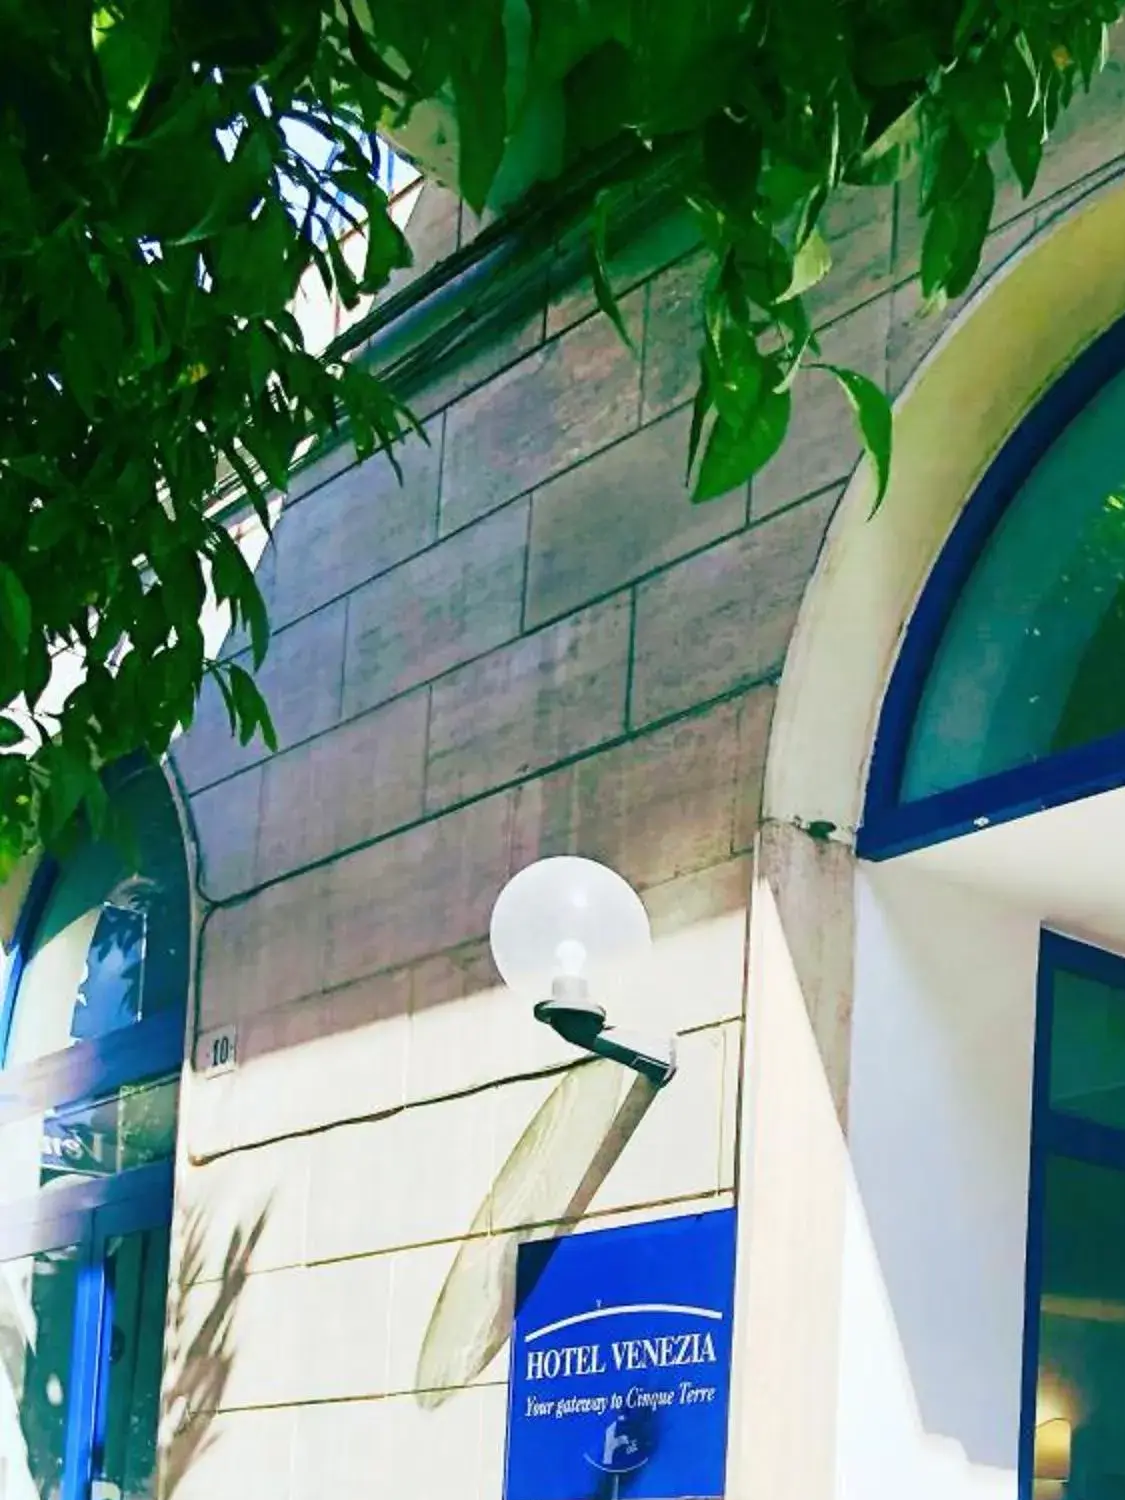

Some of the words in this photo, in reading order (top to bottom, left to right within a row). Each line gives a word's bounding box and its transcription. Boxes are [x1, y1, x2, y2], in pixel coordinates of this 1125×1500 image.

[213, 1036, 229, 1067] 10
[525, 1344, 606, 1381] HOTEL
[610, 1332, 717, 1371] VENEZIA
[525, 1395, 554, 1417] Your
[555, 1395, 607, 1419] gateway
[610, 1392, 624, 1409] to
[626, 1386, 675, 1411] Cinque
[678, 1381, 717, 1404] Terre
